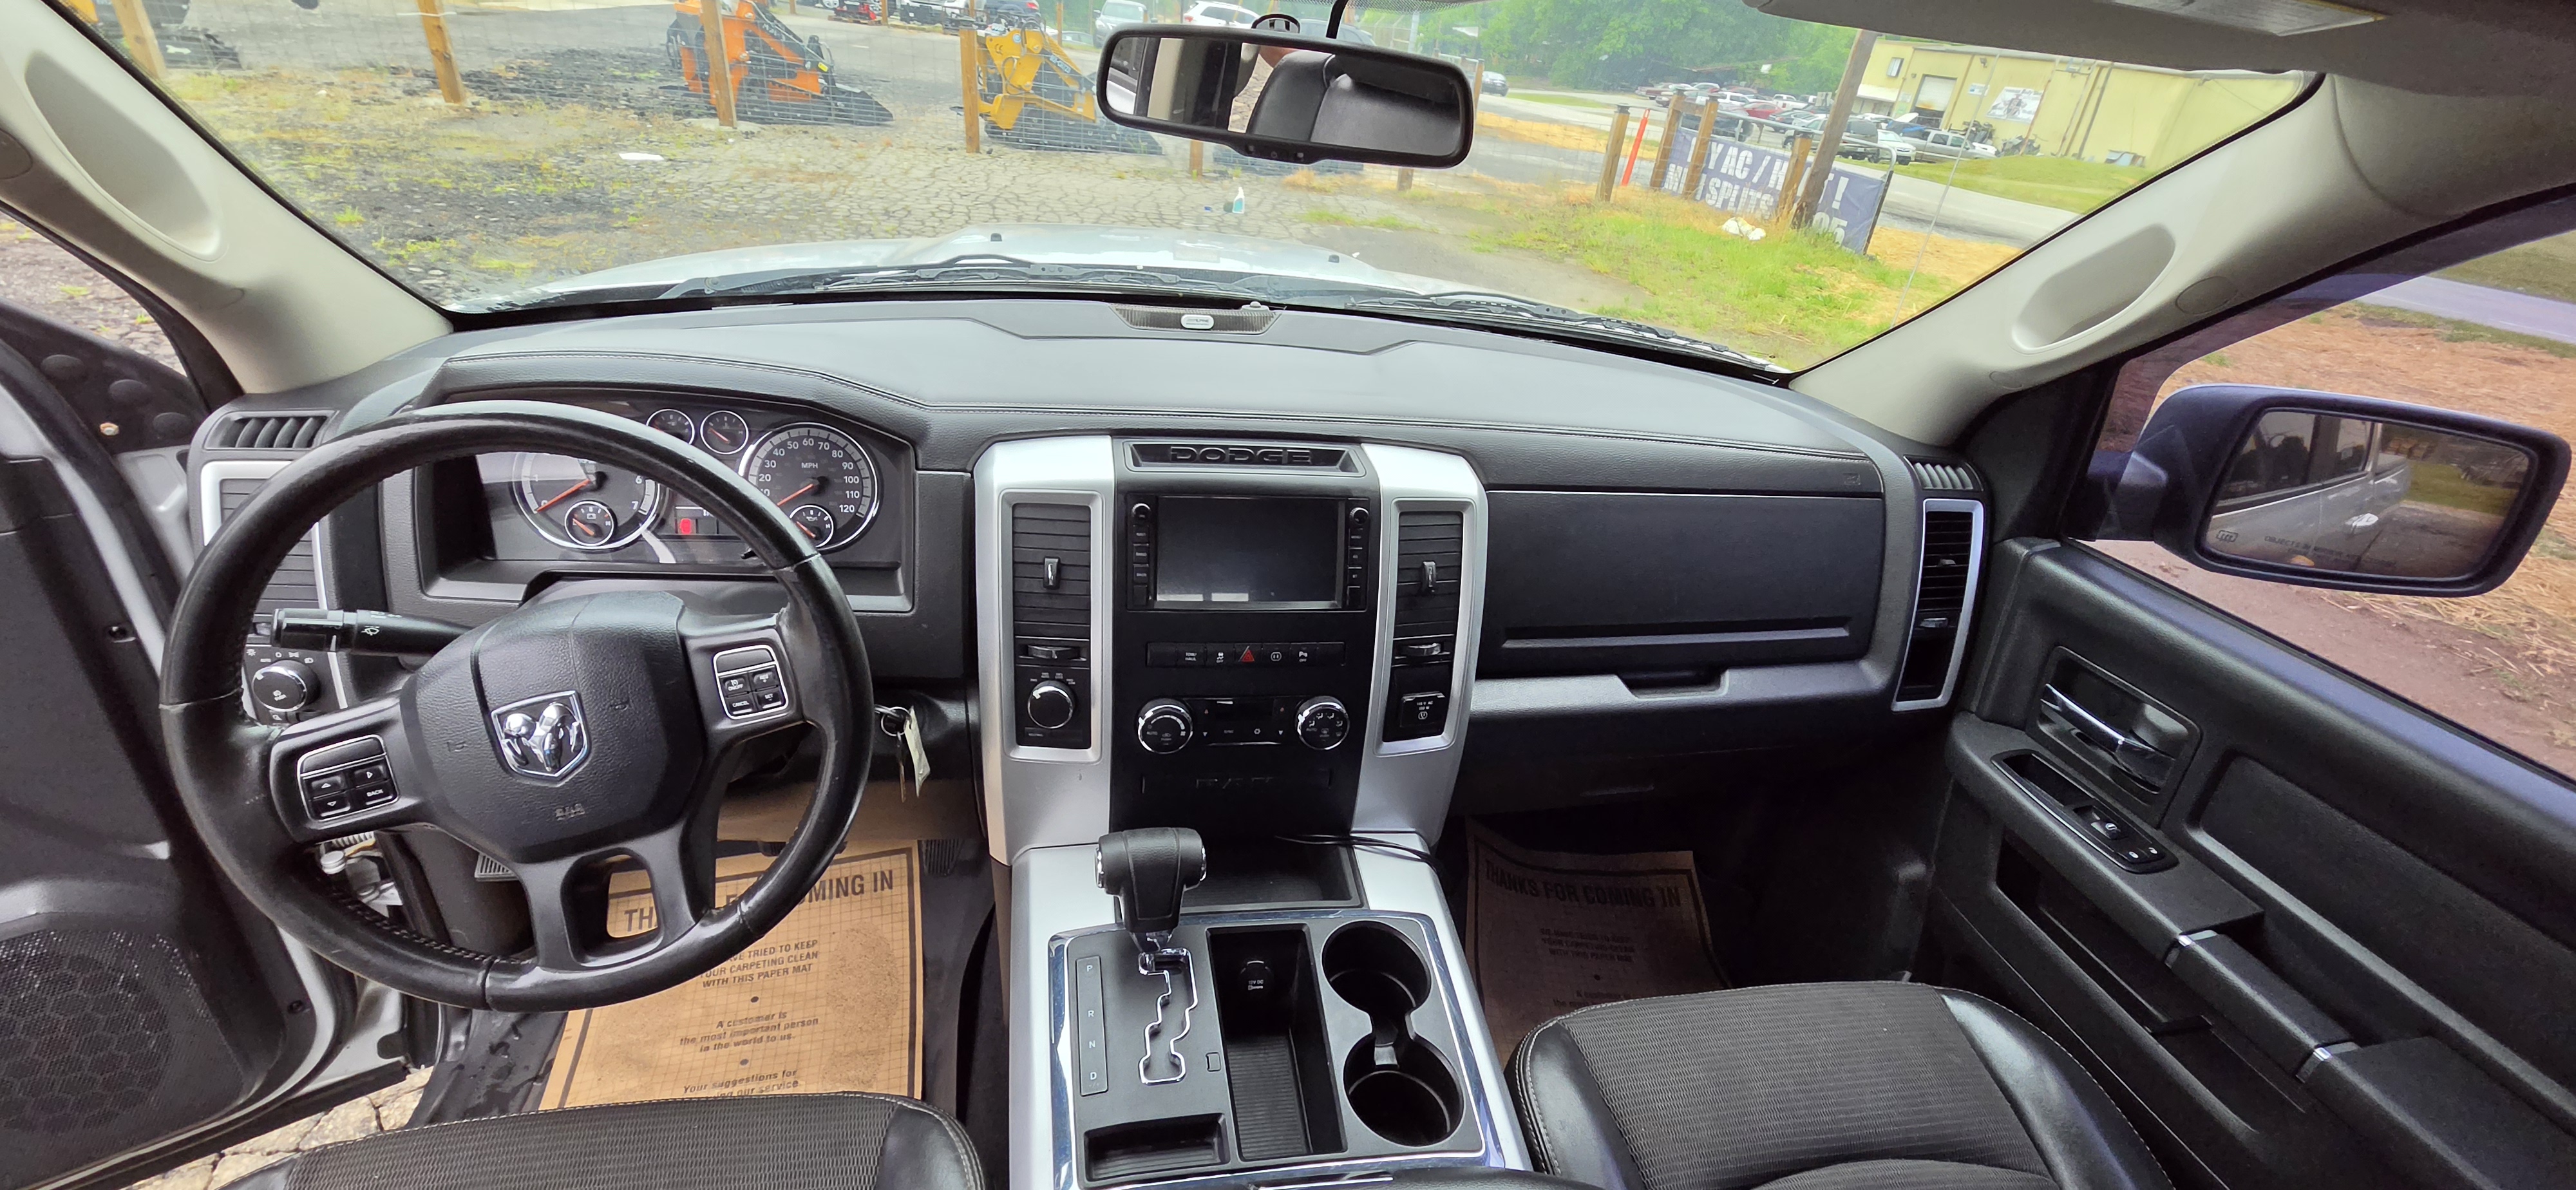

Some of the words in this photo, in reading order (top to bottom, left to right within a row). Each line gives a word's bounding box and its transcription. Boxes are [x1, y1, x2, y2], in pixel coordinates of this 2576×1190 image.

[1720, 146, 1753, 180] AC
[787, 441, 799, 449] 50
[818, 442, 830, 450] 70
[1171, 446, 1312, 465] DODGE
[764, 460, 777, 468] 30
[635, 475, 643, 484] 6
[632, 501, 639, 510] 7
[366, 789, 384, 797] BACK
[799, 874, 864, 905] MING
[873, 869, 893, 892] IN
[1485, 860, 1539, 898] THANKS
[1543, 882, 1579, 903] FOR
[1582, 884, 1656, 907] COMING
[748, 947, 775, 958] TRIED
[779, 943, 791, 953] TO
[793, 940, 818, 951] KEEP
[730, 957, 784, 974] CARPETING
[787, 951, 819, 964] CLEAN
[703, 978, 728, 988] WITH
[732, 974, 754, 984] THIS
[757, 967, 789, 980] PAPER
[792, 963, 813, 974] MAT
[716, 1021, 723, 1029] A
[726, 1014, 775, 1028] customer
[680, 1037, 696, 1046] the
[700, 1031, 726, 1043] most
[729, 1023, 781, 1038] important
[783, 1017, 819, 1031] person
[713, 1042, 730, 1051] the
[734, 1035, 763, 1047] world
[766, 1035, 776, 1043] to
[683, 1083, 708, 1094] Your
[712, 1072, 778, 1090] suggestions
[782, 1069, 799, 1078] for
[1090, 1072, 1097, 1081] D
[758, 1079, 799, 1094] service
